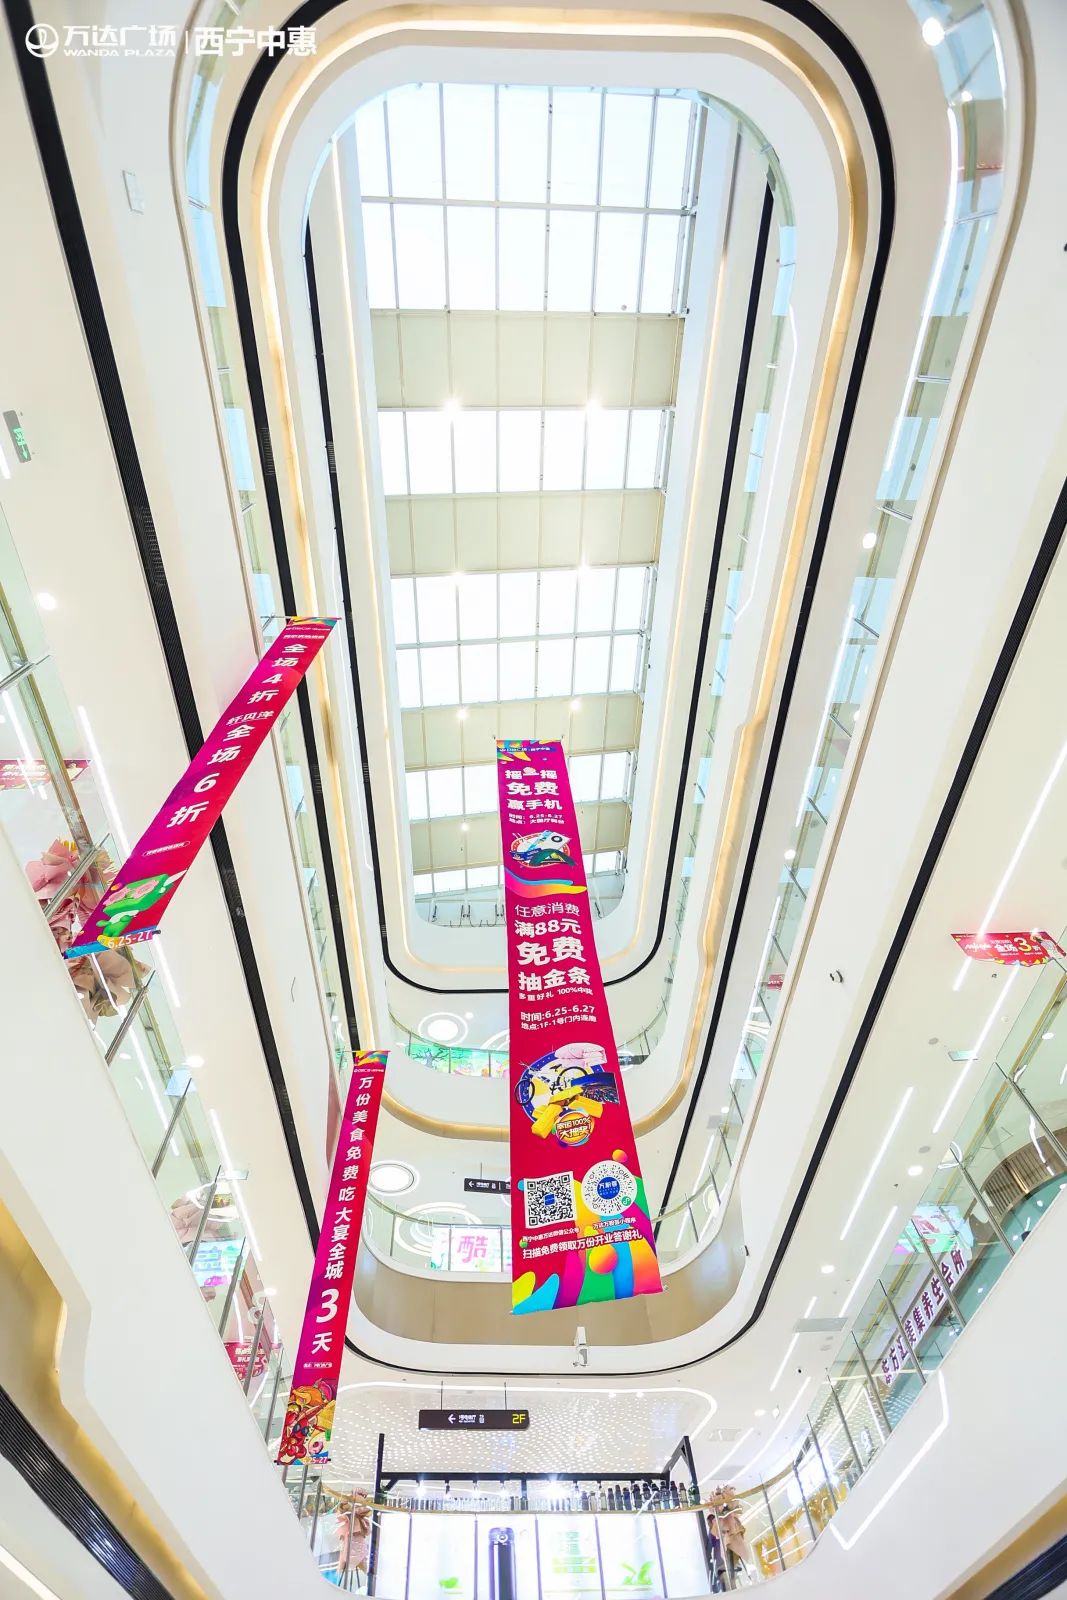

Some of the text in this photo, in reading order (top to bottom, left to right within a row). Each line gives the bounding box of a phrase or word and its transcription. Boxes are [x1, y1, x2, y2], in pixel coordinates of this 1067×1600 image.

[507, 782, 560, 796] 免费
[514, 902, 581, 918] 任意消费
[514, 918, 582, 938] 满88元
[516, 936, 587, 966] 免费
[518, 966, 591, 992] 抽金条
[523, 1229, 643, 1259] 扫描免费领取万份开业答谢礼
[512, 1413, 526, 1424] 2F
